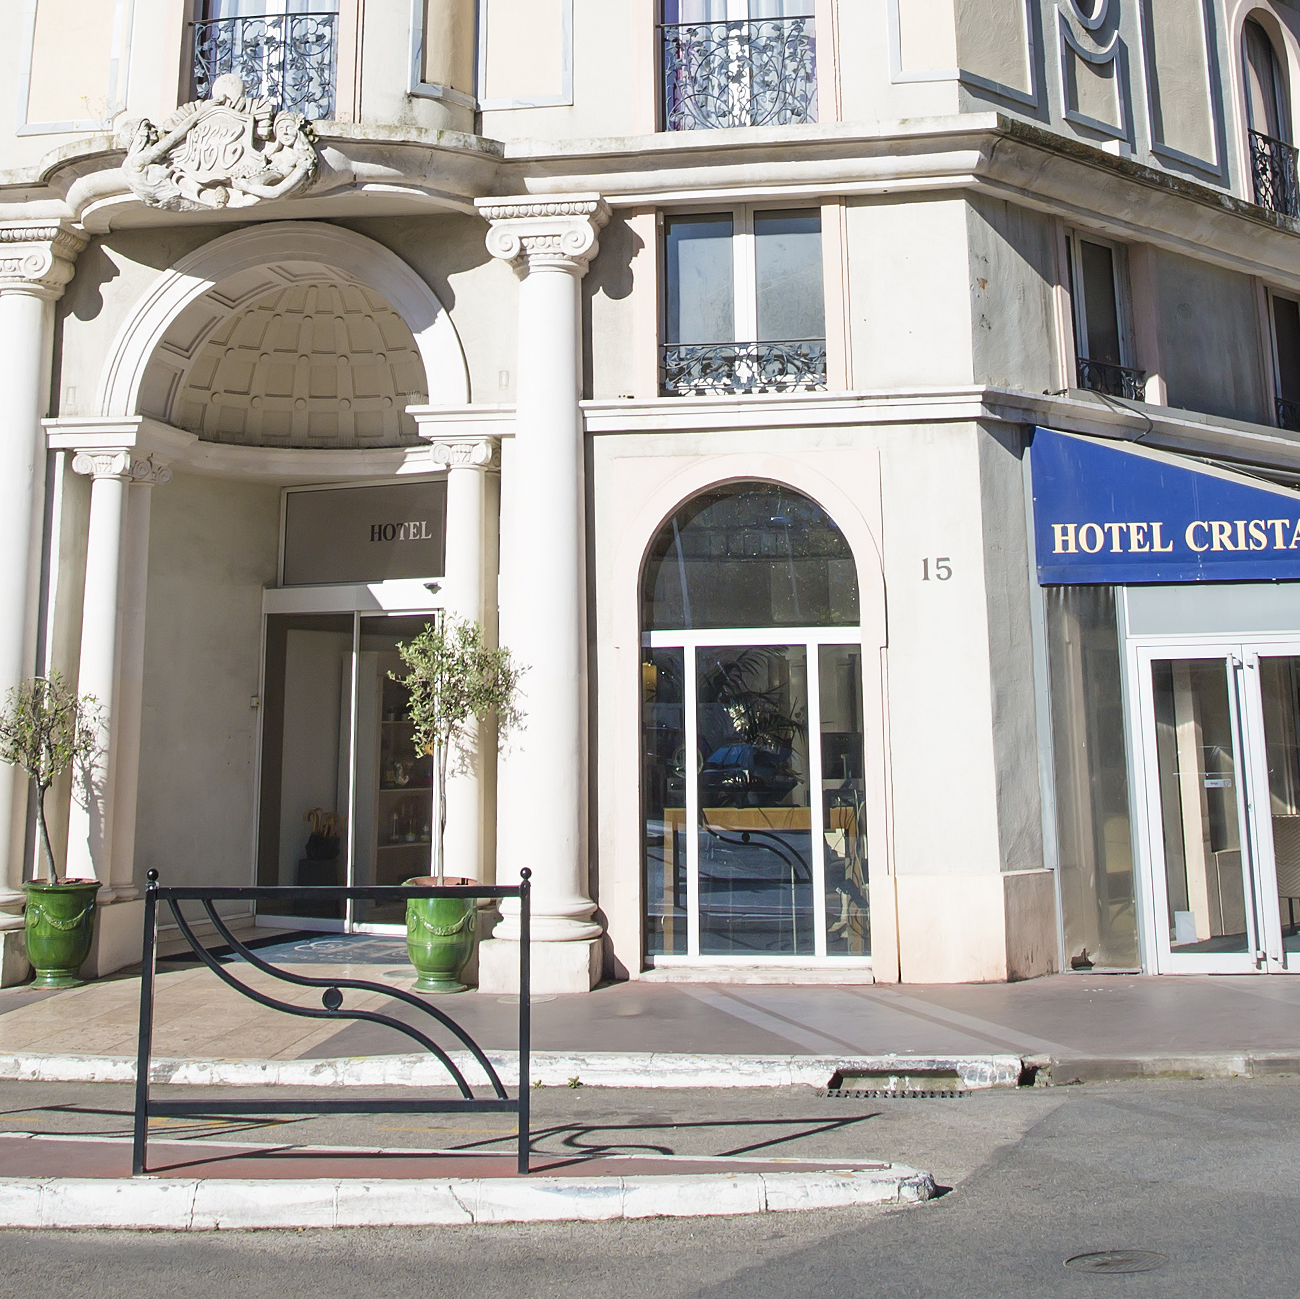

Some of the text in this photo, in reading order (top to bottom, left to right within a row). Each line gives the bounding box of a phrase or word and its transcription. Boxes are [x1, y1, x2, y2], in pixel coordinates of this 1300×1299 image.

[370, 521, 433, 542] HOTEL
[1051, 521, 1174, 554] HOTEL
[922, 557, 953, 581] 15
